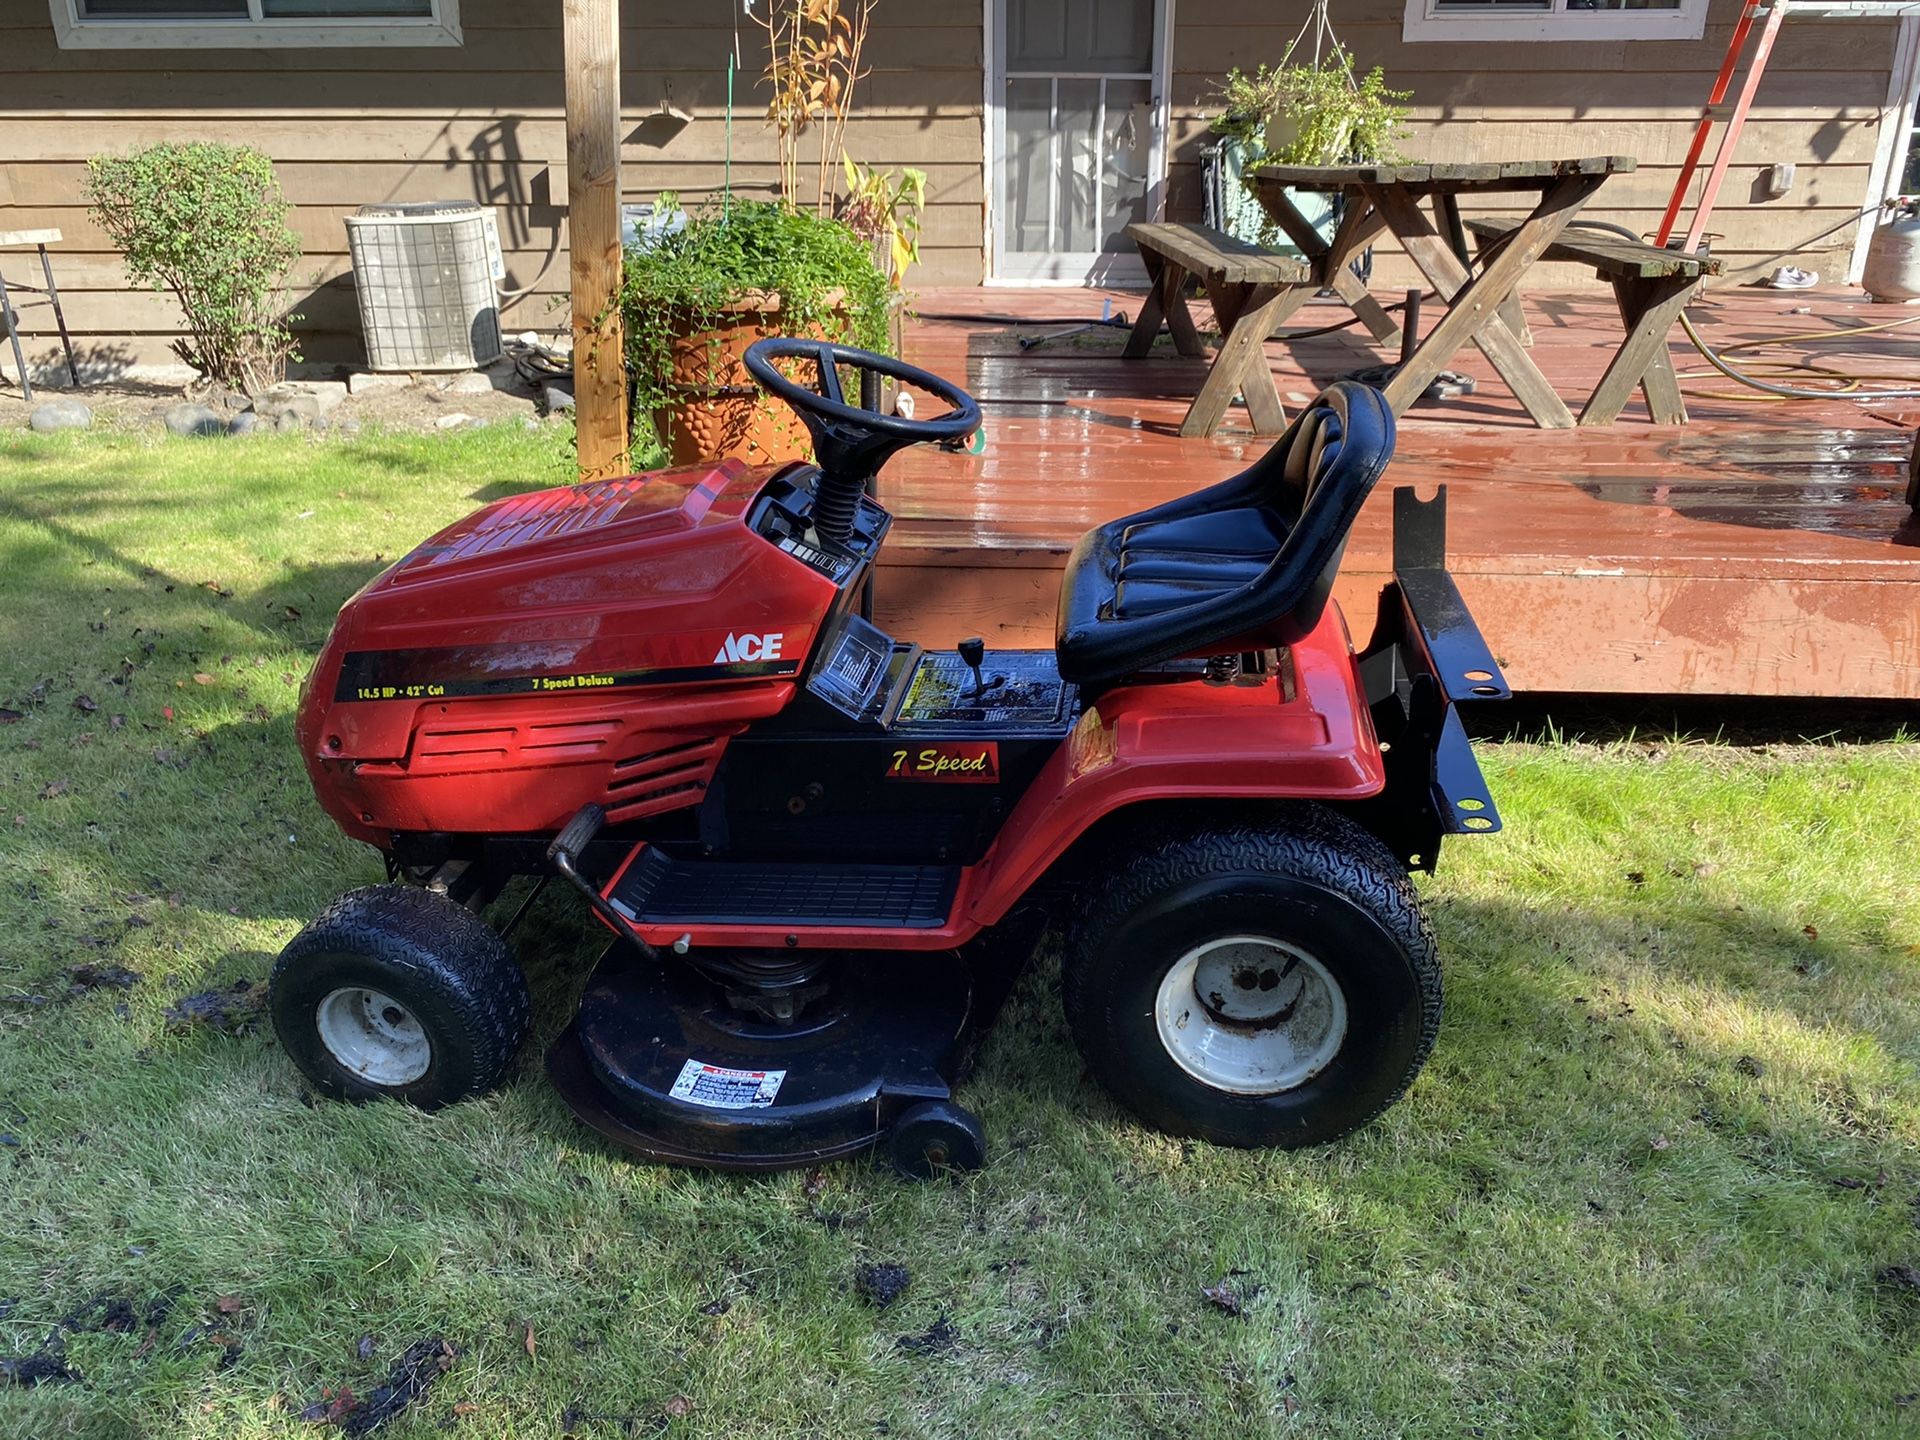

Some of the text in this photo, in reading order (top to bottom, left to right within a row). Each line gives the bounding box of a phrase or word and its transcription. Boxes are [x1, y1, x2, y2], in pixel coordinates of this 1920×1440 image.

[713, 632, 783, 663] ACE
[357, 684, 444, 699] 14.5 HP 42" Cut
[532, 675, 614, 690] 7 Speed Deluxe
[893, 749, 986, 776] 7 Speed
